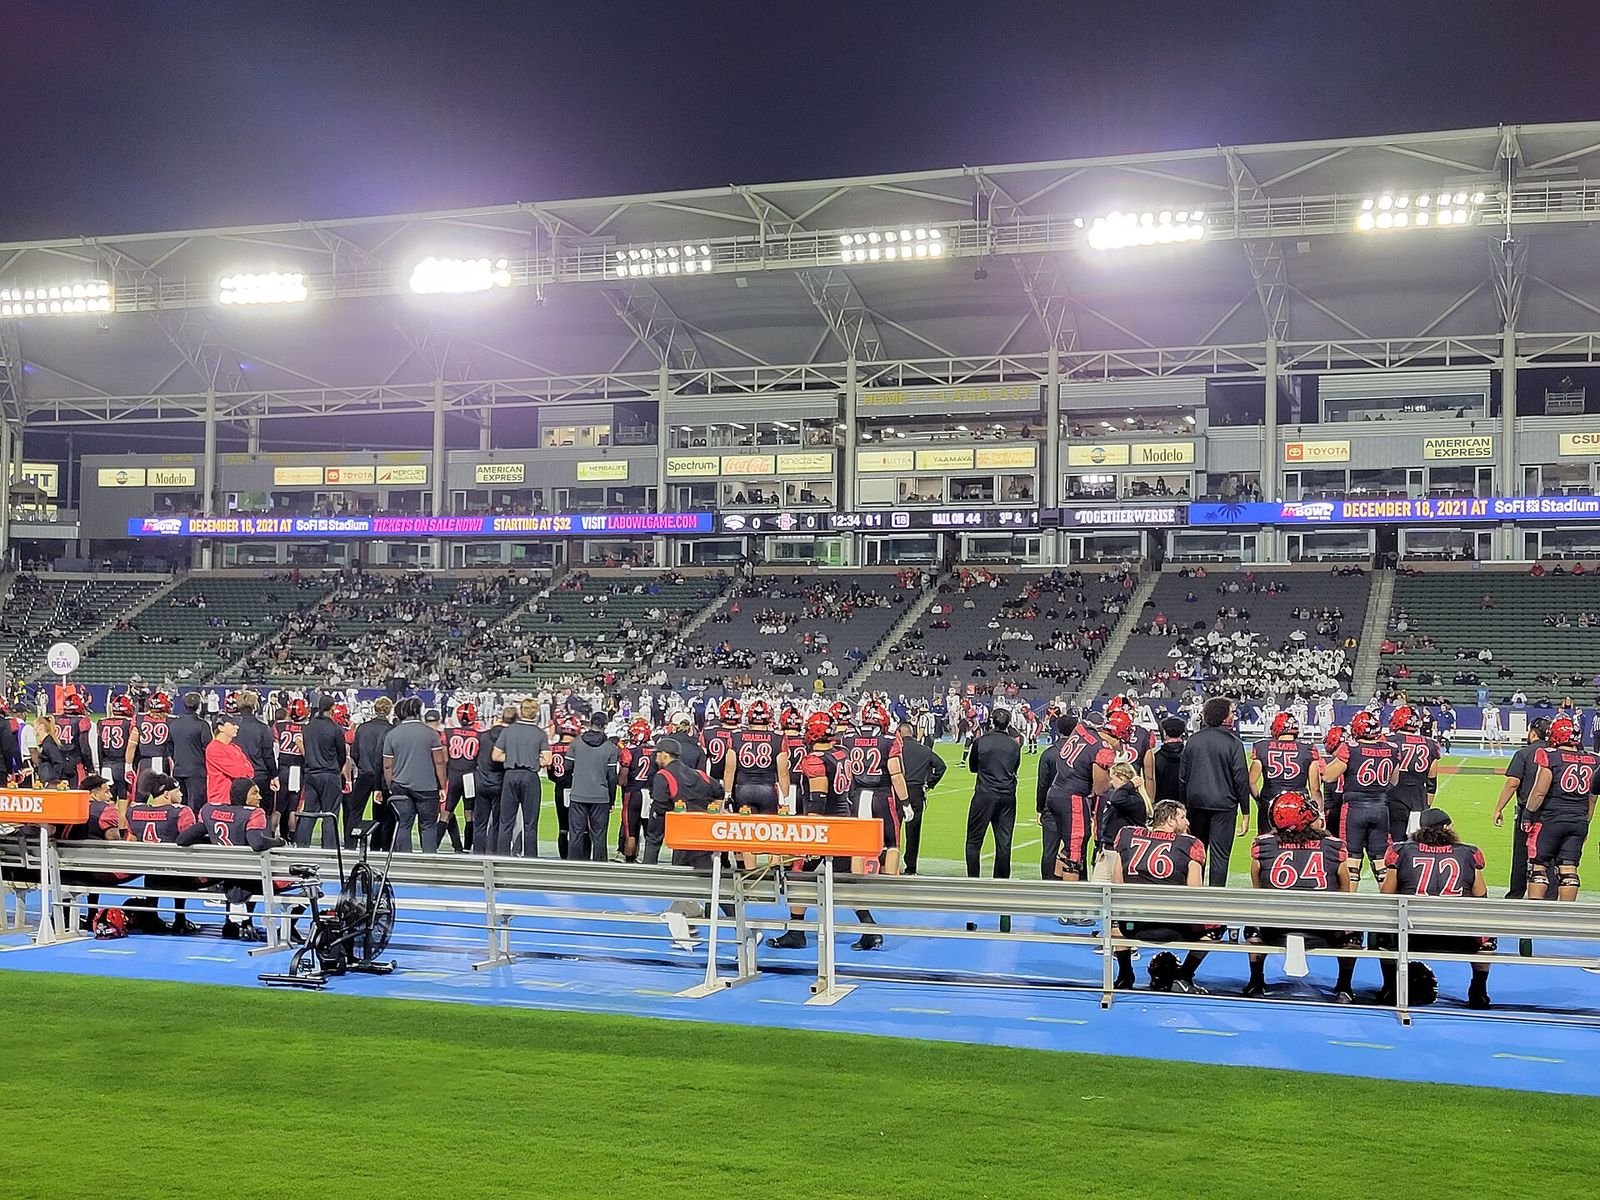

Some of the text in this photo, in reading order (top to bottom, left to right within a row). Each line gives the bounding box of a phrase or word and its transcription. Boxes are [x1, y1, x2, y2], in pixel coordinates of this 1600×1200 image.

[1307, 447, 1348, 455] TOYOTA
[1425, 438, 1490, 448] AMERICAN
[1434, 447, 1491, 457] EXPRESS
[1142, 447, 1184, 462] Modelo
[477, 465, 523, 474] AMERICAN
[668, 460, 714, 473] Spectrum
[155, 472, 187, 484] Modelo
[483, 473, 523, 482] EXPRESS
[932, 512, 981, 525] BALL ON 44
[1014, 513, 1022, 524] &
[1343, 499, 1599, 519] DECEMBER 18, 2021 AT SoFi Stadium
[189, 515, 698, 534] DECEMBER 18, 2021 AT SoFi Stadium TICKETS ON SALE NOW! STARTING AT $32 VISIT LABOWLGAME.COM
[752, 517, 761, 529] 0
[806, 516, 815, 528] 0
[831, 515, 861, 527] 12:34
[875, 514, 882, 526] 1
[894, 515, 907, 524] 18
[51, 661, 72, 669] PEAK
[101, 726, 124, 748] 43
[140, 722, 169, 745] 39
[449, 735, 479, 760] 80
[708, 738, 725, 764] 9
[739, 742, 772, 768] 68
[1060, 735, 1087, 768] 61
[850, 747, 882, 775] 82
[1267, 750, 1300, 780] 55
[1399, 744, 1430, 773] 73
[1357, 758, 1393, 787] 60
[1561, 764, 1593, 795] 63
[0, 796, 43, 813] RADE
[143, 822, 161, 843] 4
[711, 821, 830, 843] GATORADE
[1146, 831, 1177, 842] THOMAS
[1128, 838, 1174, 879] 76
[1270, 851, 1328, 889] 64
[1413, 857, 1463, 897] 72
